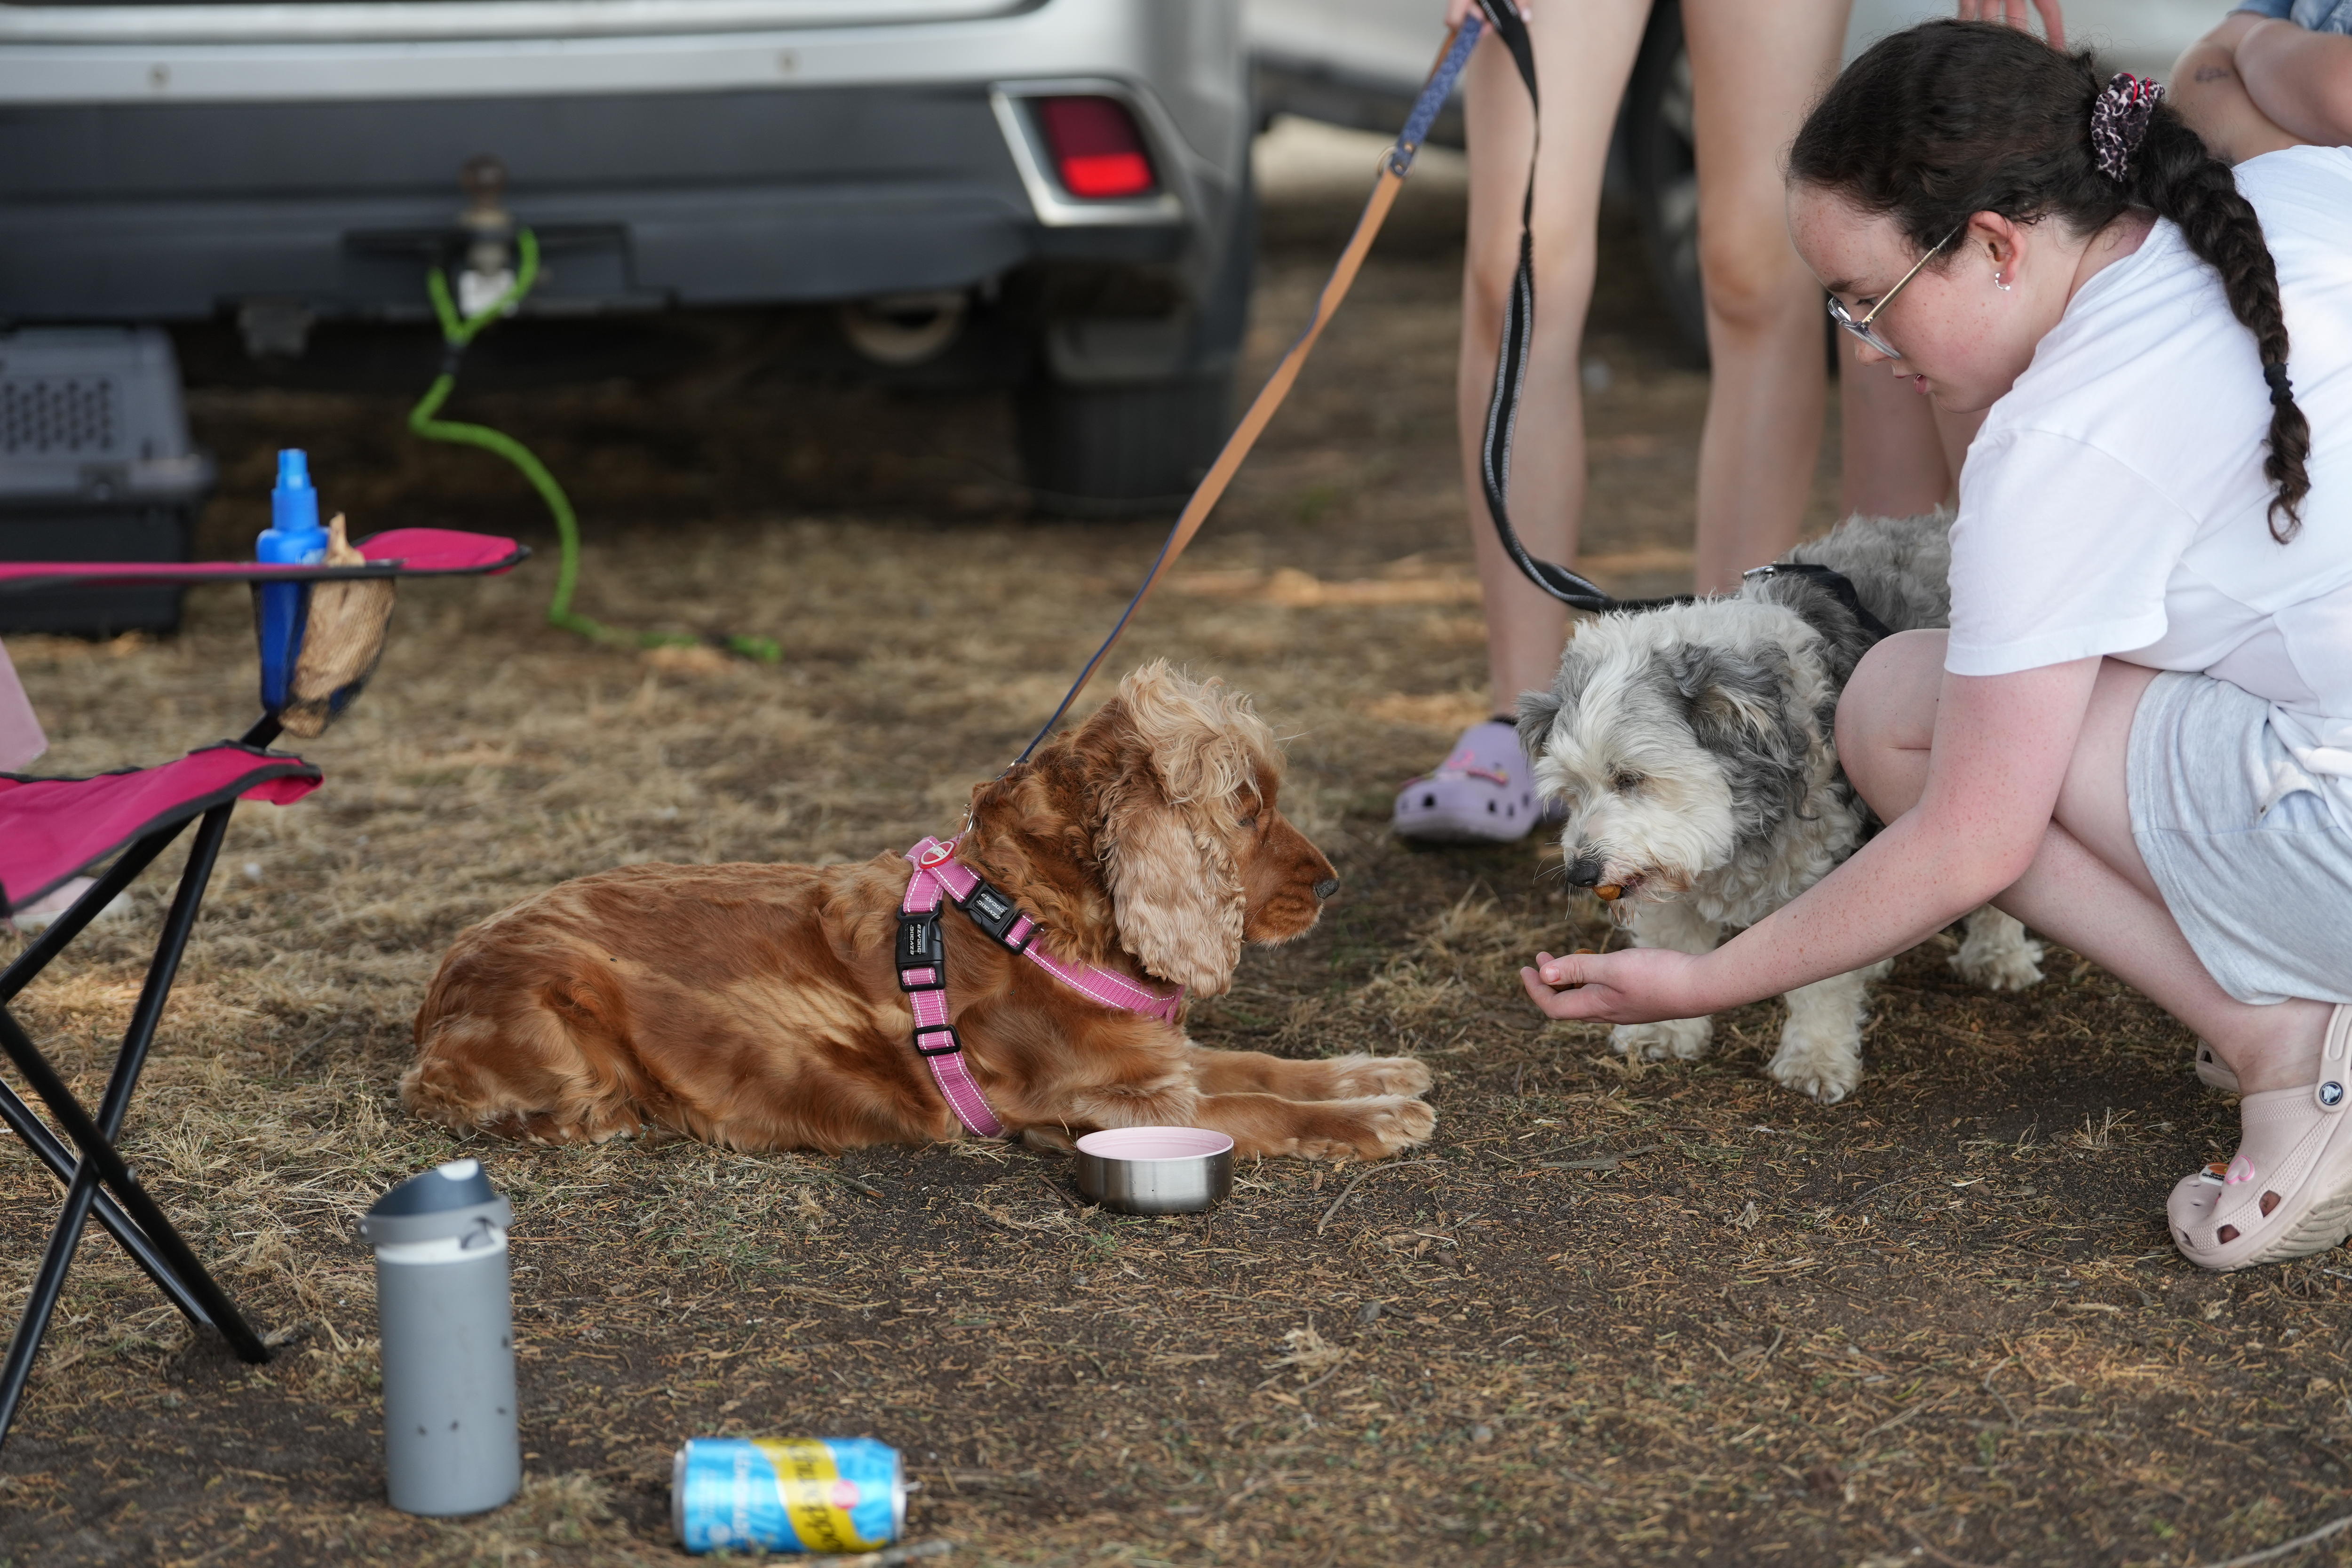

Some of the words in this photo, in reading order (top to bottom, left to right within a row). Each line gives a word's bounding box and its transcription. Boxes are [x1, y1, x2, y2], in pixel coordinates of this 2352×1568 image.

[977, 900, 1001, 919] EZYDOG
[981, 893, 1004, 913] EZYDOG
[2327, 1167, 2352, 1187] olorado
[778, 1438, 843, 1551] Schweppe
